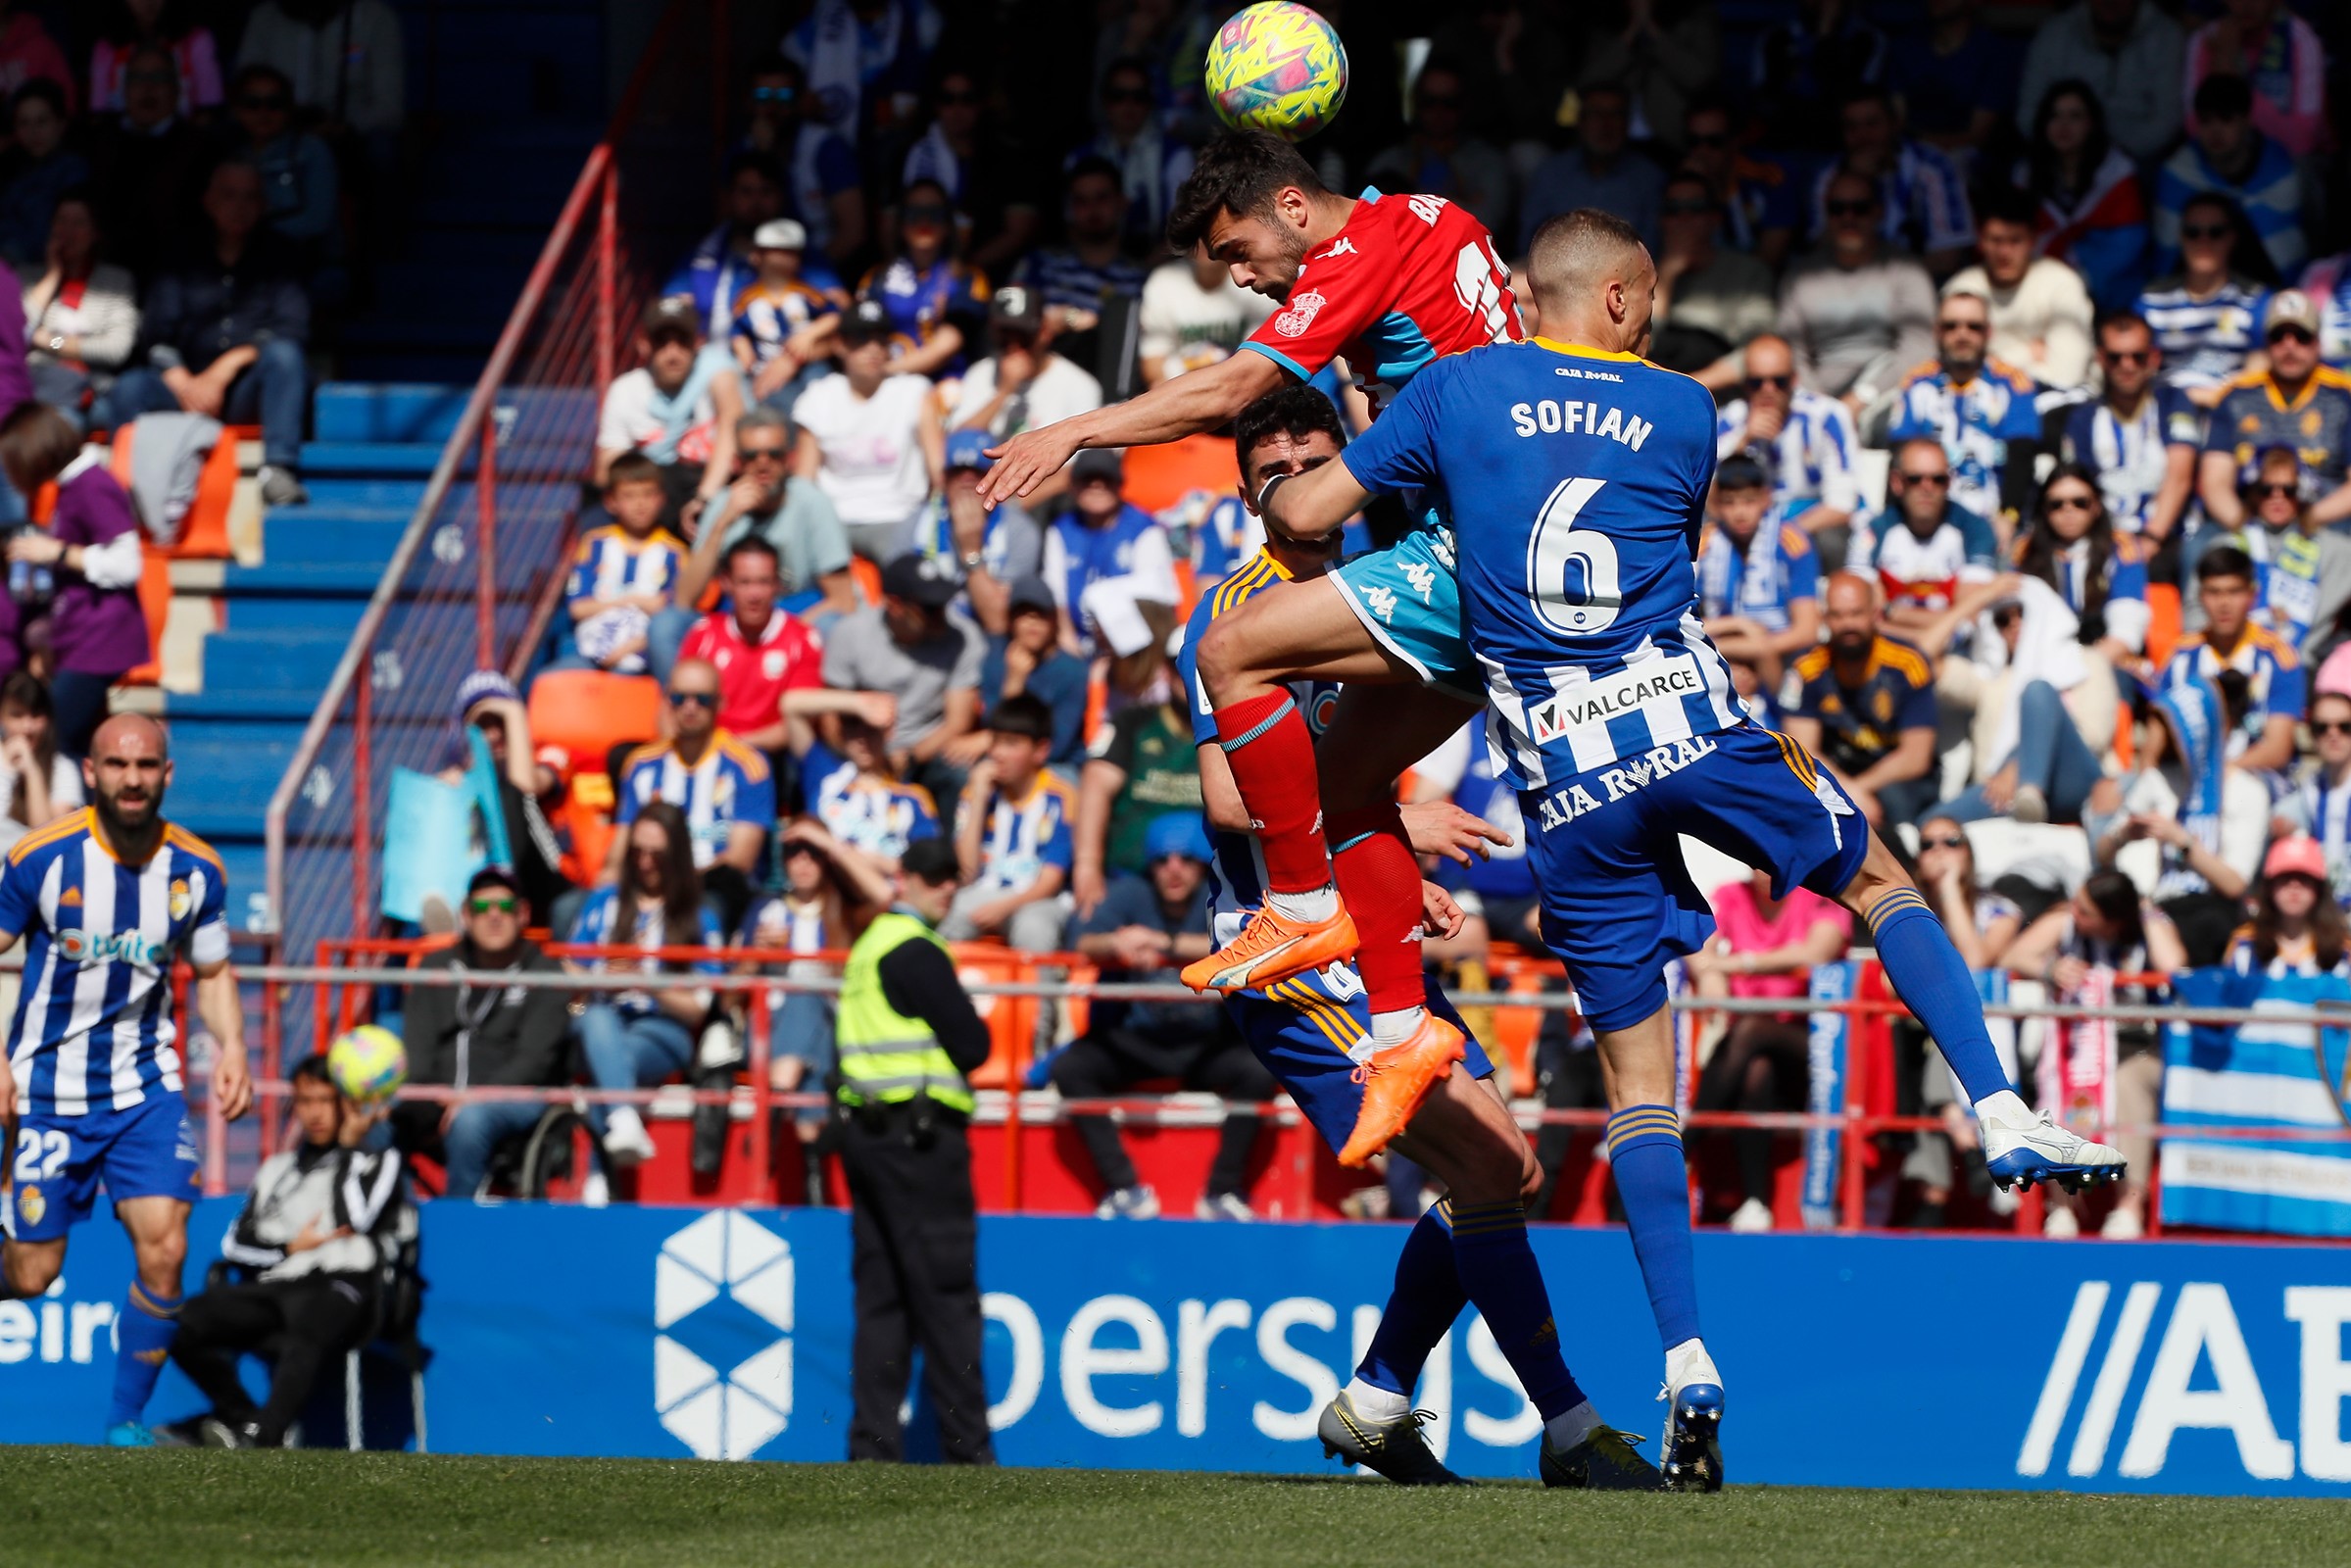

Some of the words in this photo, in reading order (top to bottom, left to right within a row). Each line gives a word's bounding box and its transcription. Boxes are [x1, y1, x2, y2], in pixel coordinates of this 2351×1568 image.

[1554, 368, 1583, 380] CAJA
[1510, 399, 1653, 453] SOFIAN
[1526, 476, 1623, 637] 6
[1567, 669, 1696, 725] VALCARCE
[1539, 784, 1602, 833] AJA
[15, 1127, 72, 1182] 22
[0, 1274, 121, 1364] eir
